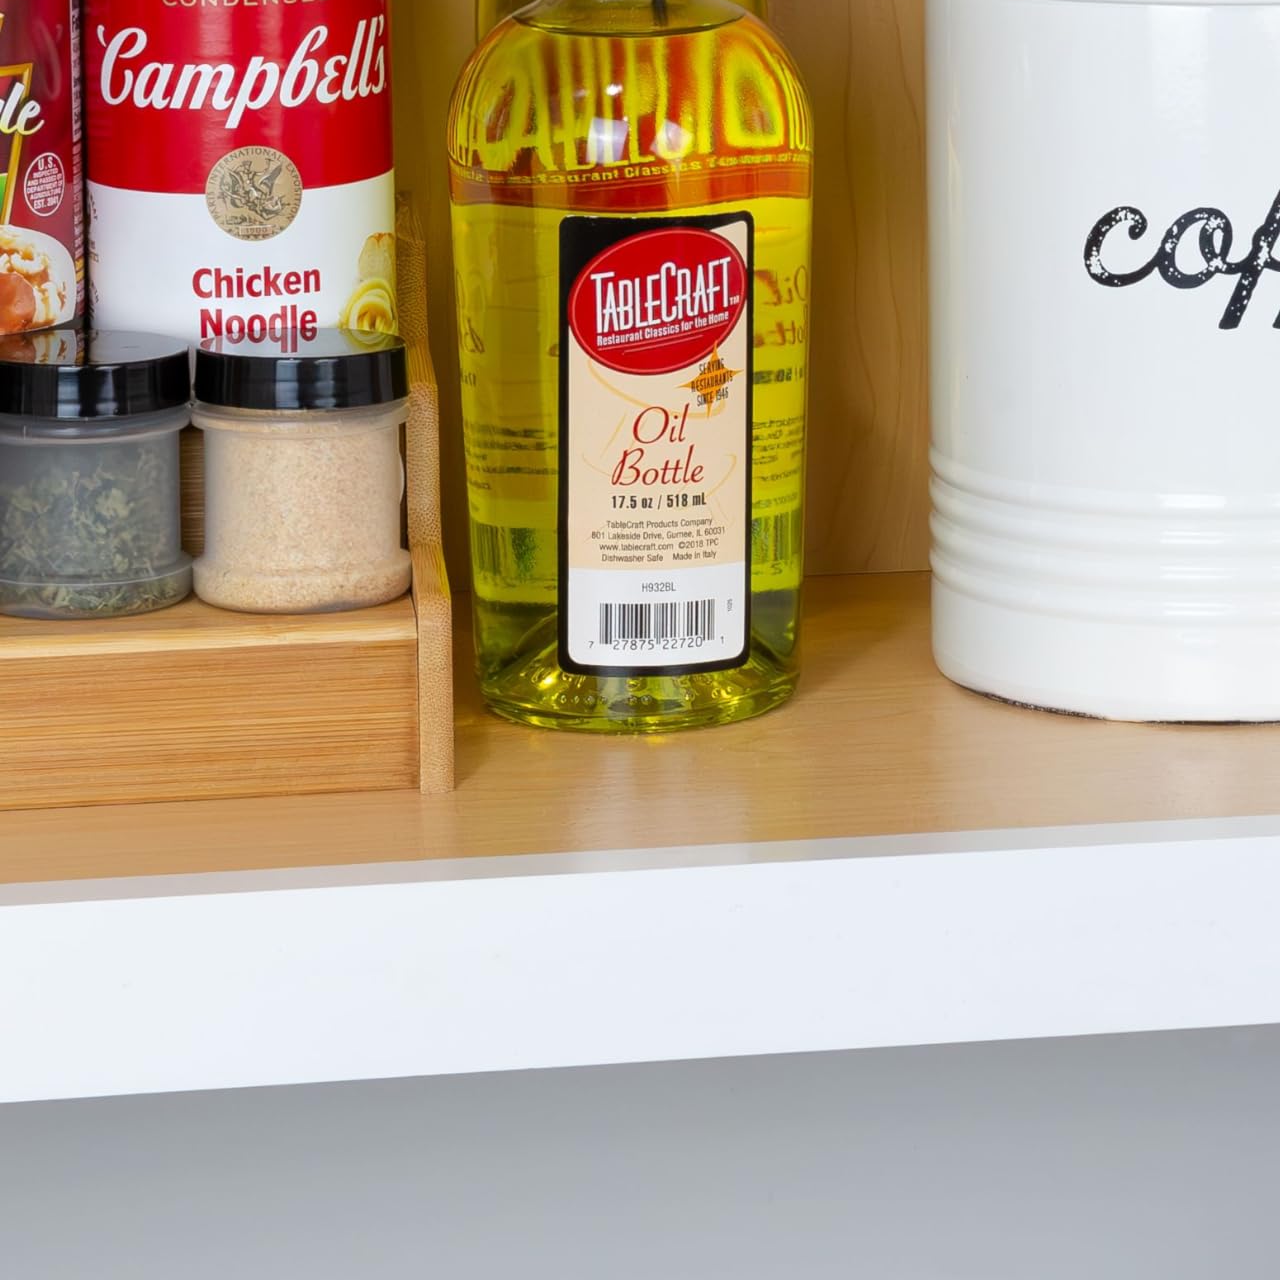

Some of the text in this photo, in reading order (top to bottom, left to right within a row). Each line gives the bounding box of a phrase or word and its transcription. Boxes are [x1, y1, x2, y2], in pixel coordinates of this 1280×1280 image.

[192, 265, 321, 299] Chicken
[199, 304, 318, 340] Noodle
[597, 311, 729, 347] Restaurant Classics for the Home
[697, 389, 714, 407] SINCE
[632, 402, 690, 444] Oil
[611, 443, 704, 487] Bottle
[612, 495, 637, 509] 17.5
[641, 497, 653, 509] oz
[666, 493, 689, 508] 518
[692, 492, 707, 506] mL
[607, 518, 713, 529] TableCraft Products Company
[591, 531, 605, 540] 801
[607, 531, 641, 540] Lakeside
[643, 531, 664, 541] Drive,
[696, 528, 702, 537] IL
[704, 526, 725, 536] 60031
[600, 542, 674, 551] www.tablecraft.com
[706, 538, 719, 547] TPC
[602, 549, 717, 563] Dishwasher Safe Made in Italy
[588, 640, 594, 649] 7
[613, 639, 655, 650] 27875
[662, 636, 703, 650] 22720
